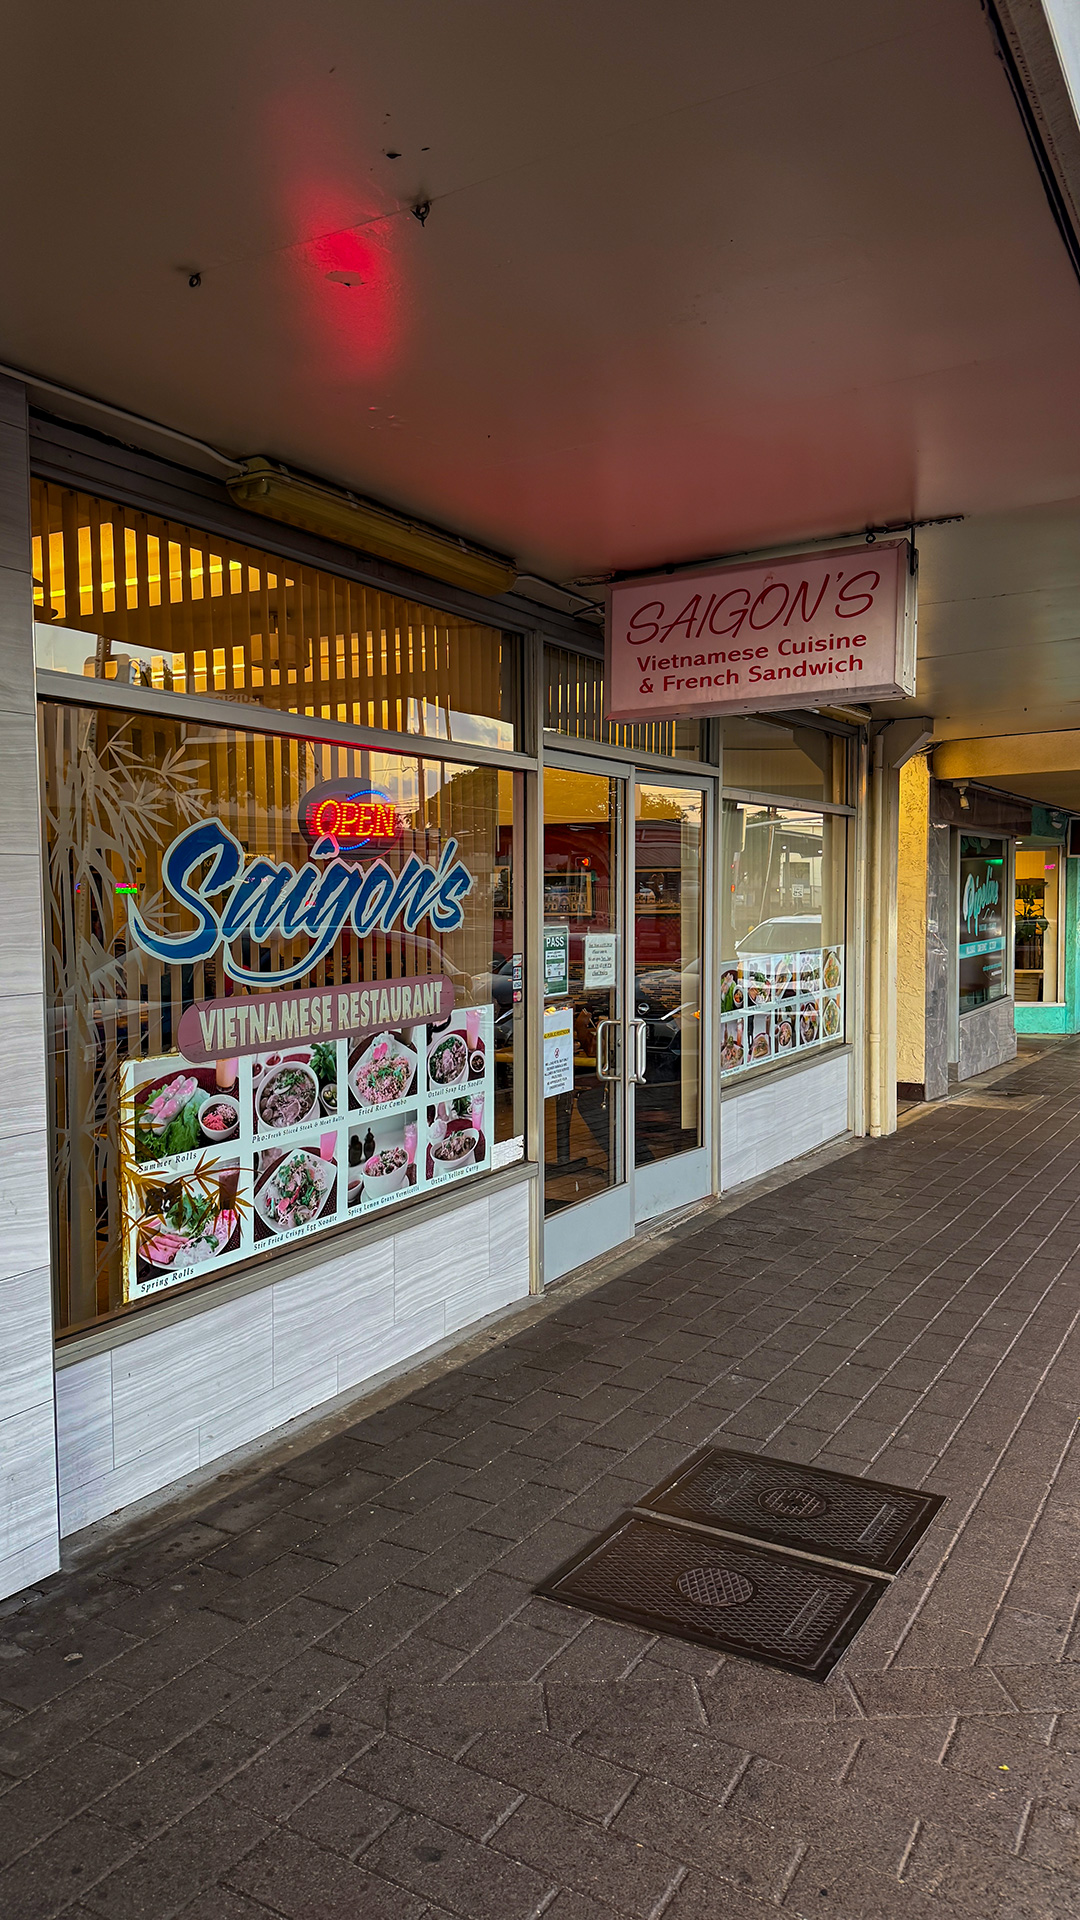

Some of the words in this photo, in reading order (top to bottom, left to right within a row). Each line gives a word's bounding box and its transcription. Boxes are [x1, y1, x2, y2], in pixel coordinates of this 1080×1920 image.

[627, 571, 880, 645] SAIGON'S
[637, 647, 768, 671] Vietnamese
[778, 634, 866, 655] Cuisine
[639, 678, 654, 693] &
[663, 670, 739, 691] French
[749, 655, 862, 682] Sandwich
[317, 800, 396, 837] OPEN
[128, 817, 474, 987] Saigon's
[546, 936, 564, 948] PASS
[199, 994, 333, 1051] VIETNAMESE
[338, 981, 442, 1030] RESTAURANT
[428, 1089, 444, 1098] Oxtail
[446, 1087, 457, 1095] Soup
[458, 1084, 466, 1092] Egg
[467, 1080, 483, 1088] Noodle
[359, 1107, 373, 1116] Fried
[376, 1104, 387, 1112] Rice
[389, 1099, 407, 1108] Combo
[283, 1127, 298, 1135] Sliced
[138, 1159, 171, 1173] Summer
[175, 1152, 197, 1163] Rolls
[431, 1175, 447, 1185] Oxtail
[448, 1170, 464, 1179] Yellow
[465, 1164, 478, 1173] Curry
[348, 1208, 362, 1216] Spicy
[364, 1201, 379, 1210] Lemon
[381, 1195, 394, 1203] Grass
[254, 1242, 266, 1250] Stir
[268, 1235, 283, 1245] Fried
[286, 1227, 304, 1239] Crispy
[306, 1223, 316, 1231] Egg
[318, 1216, 337, 1227] Noodle
[141, 1277, 168, 1293] Spring
[172, 1268, 194, 1281] Rolls
